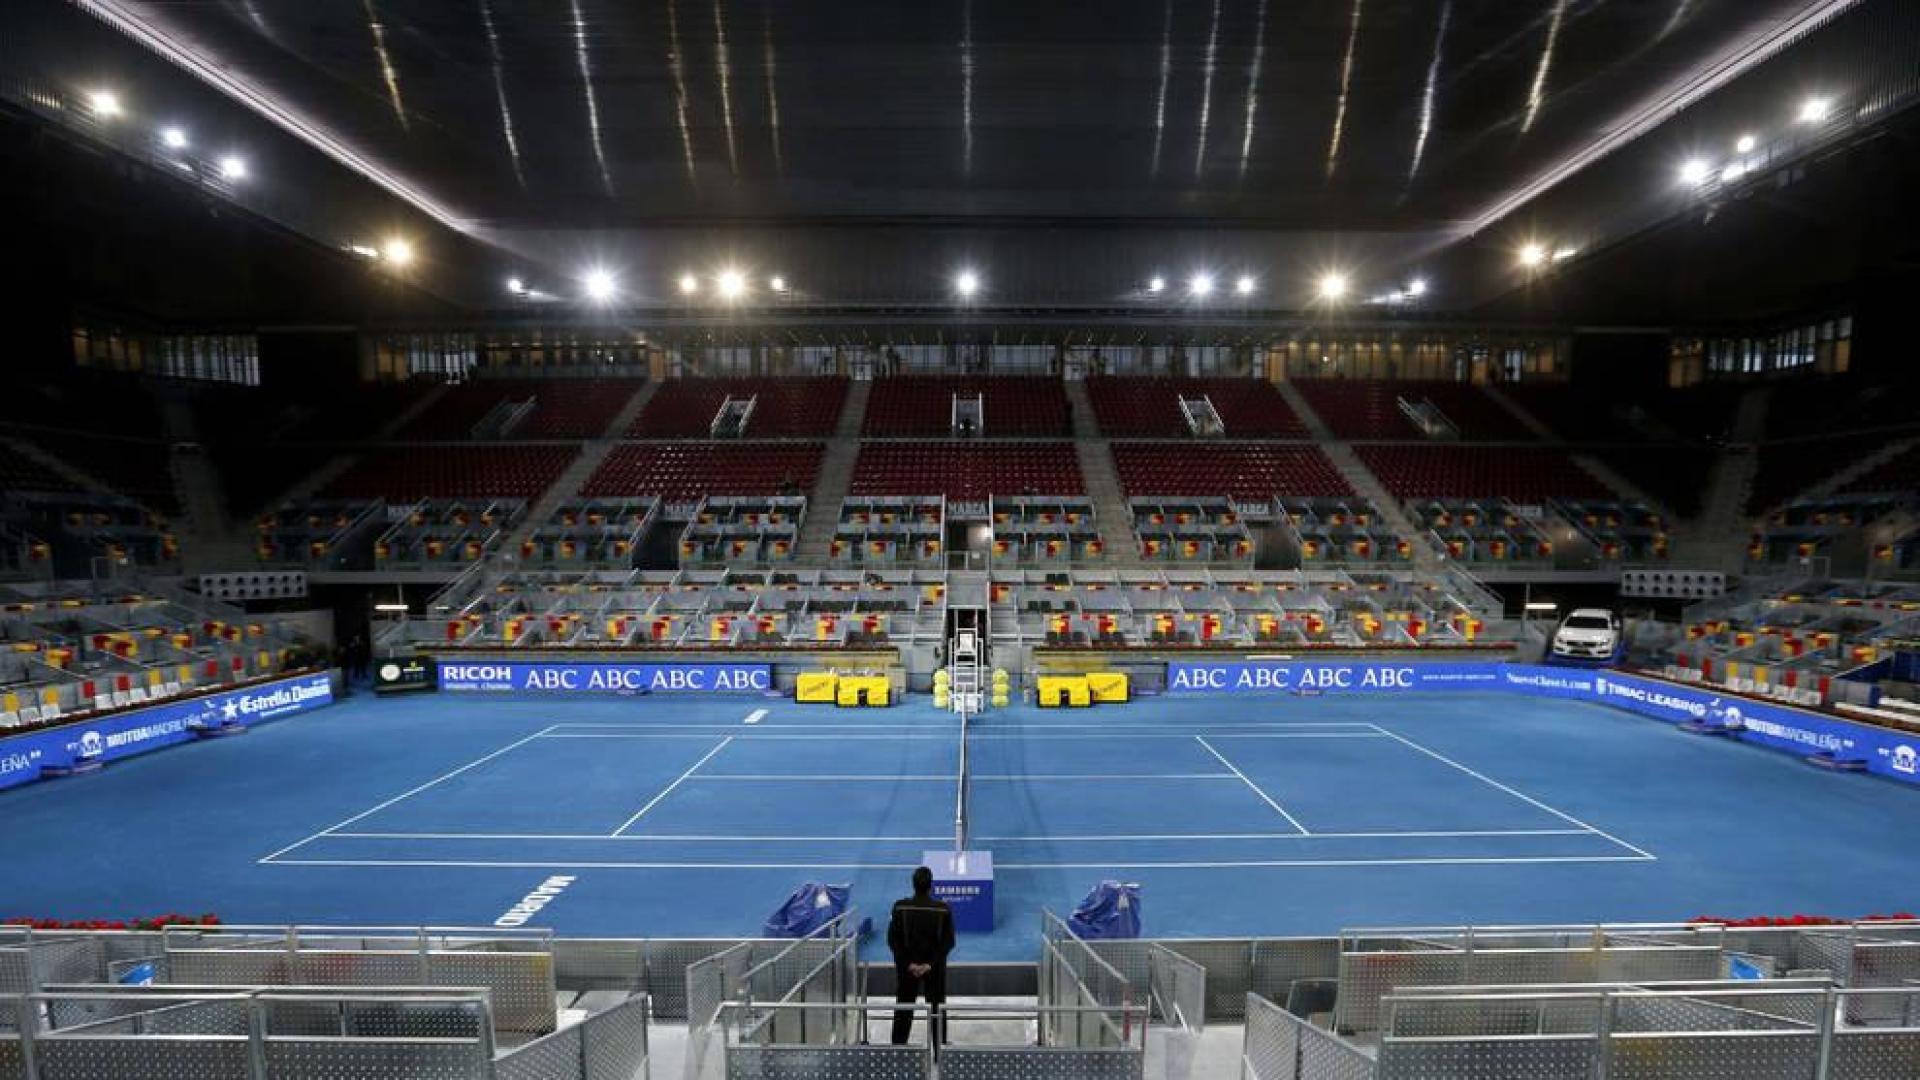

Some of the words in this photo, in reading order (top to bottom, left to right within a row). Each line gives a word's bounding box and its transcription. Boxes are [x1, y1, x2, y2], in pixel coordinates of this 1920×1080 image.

[444, 666, 511, 680] RICOH
[525, 669, 577, 689] ABC
[589, 669, 641, 689] ABC
[651, 669, 704, 689] ABC
[713, 669, 767, 689] ABC
[1172, 668, 1226, 688] ABC
[1236, 668, 1289, 688] ABC
[1298, 668, 1352, 688] ABC
[1360, 668, 1414, 688] ABC
[240, 690, 291, 714] Estrella
[1646, 691, 1706, 717] LEASING
[494, 875, 576, 926] MADRID
[935, 886, 980, 895] SAMSUNG
